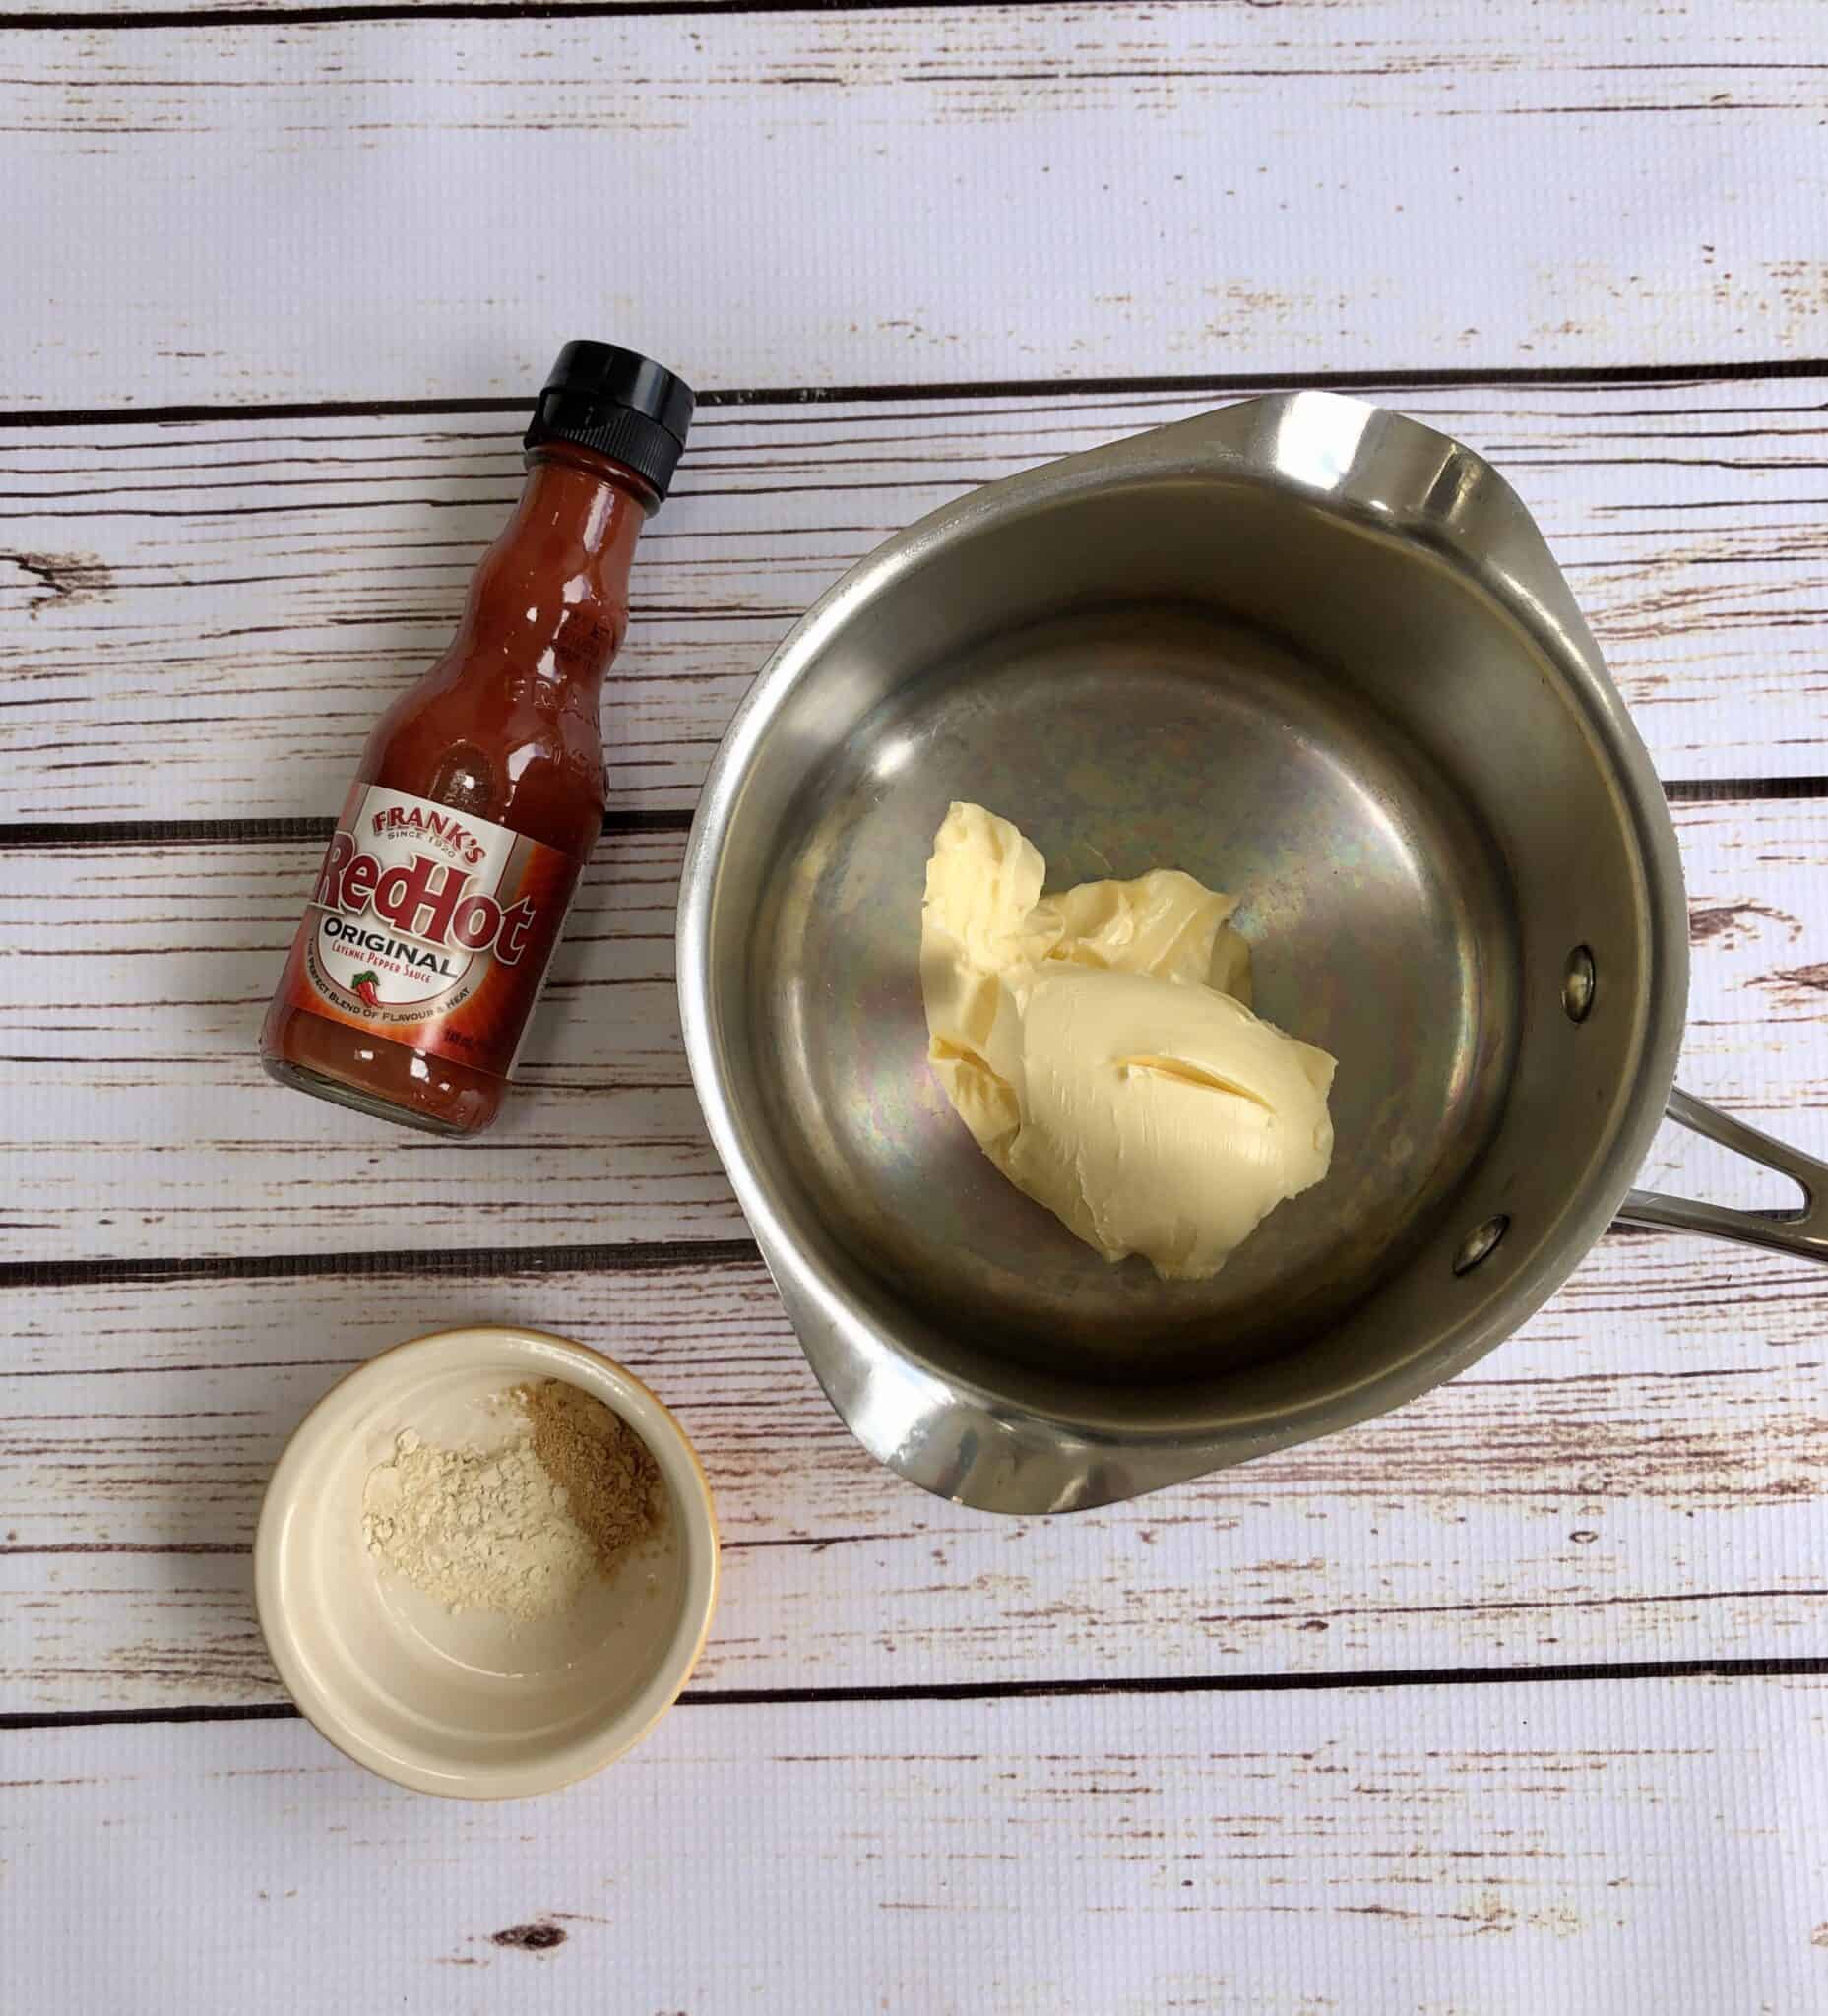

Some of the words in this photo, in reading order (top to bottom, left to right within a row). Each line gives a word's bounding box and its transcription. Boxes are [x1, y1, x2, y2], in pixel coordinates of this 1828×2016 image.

[373, 806, 486, 864] FRANK'S
[387, 829, 422, 841] SINCE
[427, 835, 457, 858] 1920
[316, 830, 536, 966] RedHot
[324, 916, 459, 979] ORIGINAL
[331, 939, 365, 962] CAYENNE
[366, 951, 402, 974] PEPPER
[403, 963, 433, 984] SAUCE
[308, 957, 331, 994] PERFECT
[328, 992, 361, 1014] BLEND
[362, 1007, 379, 1019] OF
[382, 1009, 434, 1023] FLAVOUR
[445, 987, 471, 1009] HEAT
